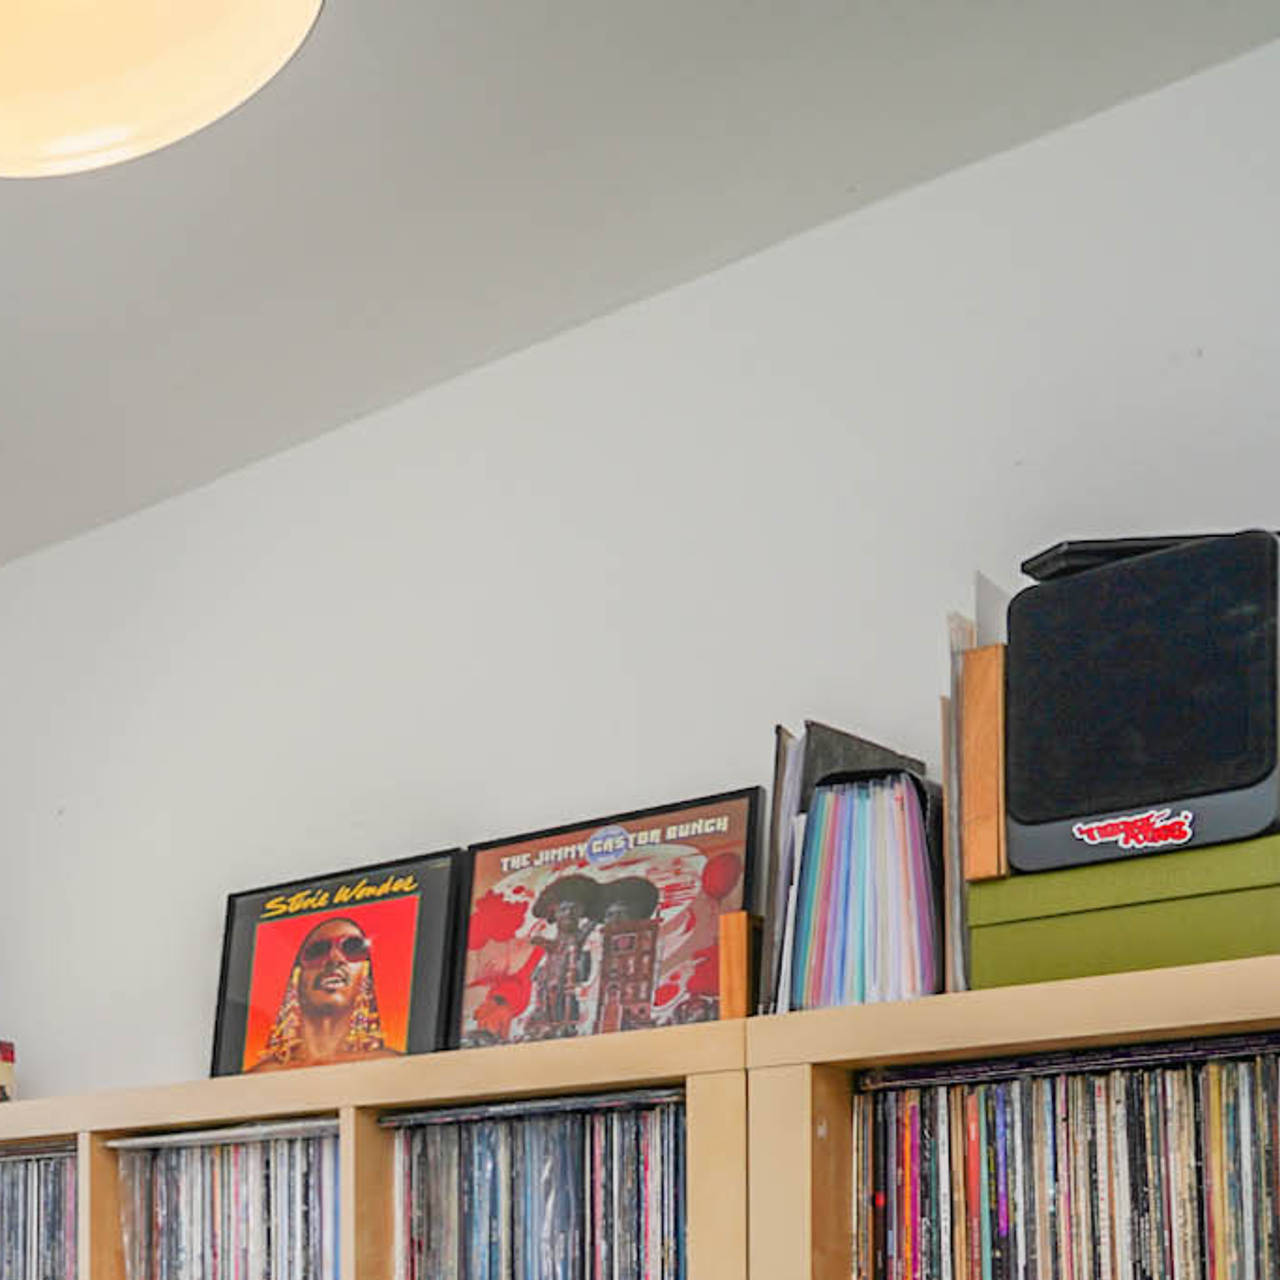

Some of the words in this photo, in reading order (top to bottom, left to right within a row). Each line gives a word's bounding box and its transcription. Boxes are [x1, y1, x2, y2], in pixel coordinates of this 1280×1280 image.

[499, 850, 532, 872] THE
[533, 842, 587, 867] JIMMY
[591, 828, 662, 855] CASTOR
[665, 815, 729, 841] BUNCH
[258, 888, 330, 919] Stevie
[333, 874, 419, 904] Wonder
